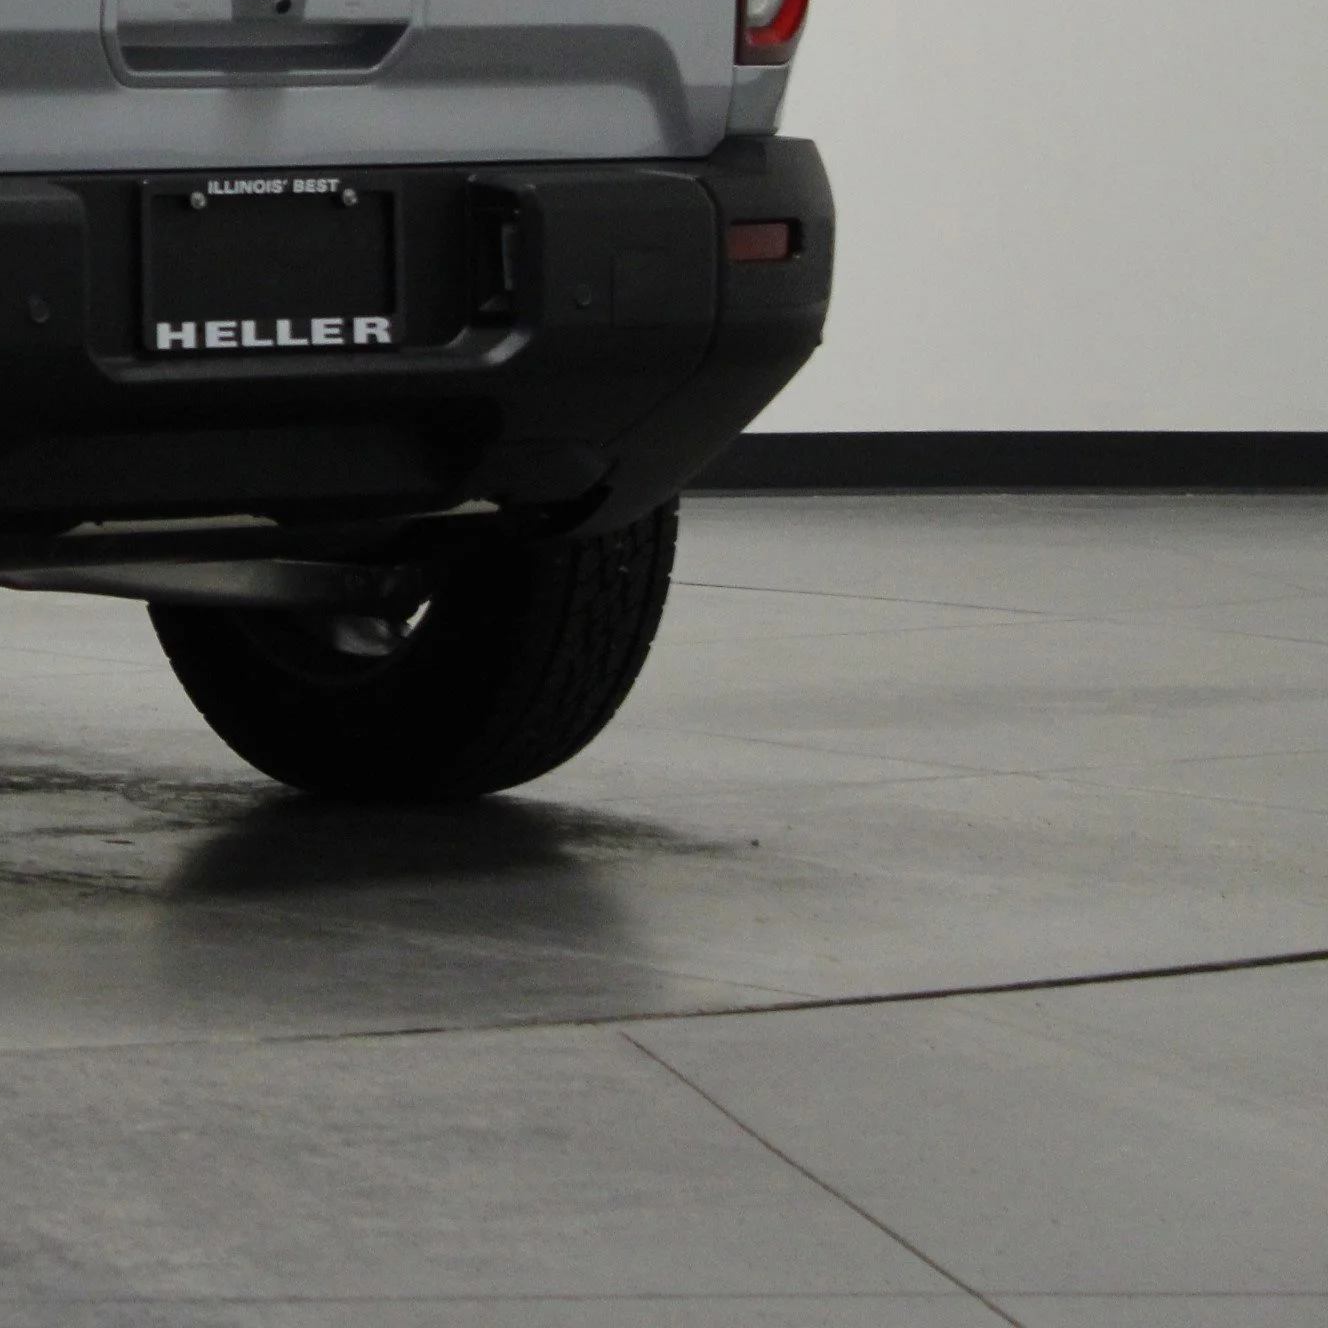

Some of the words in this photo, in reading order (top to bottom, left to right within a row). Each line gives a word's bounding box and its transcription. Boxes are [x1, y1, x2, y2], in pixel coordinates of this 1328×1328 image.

[207, 179, 288, 195] ILLINOIS'
[292, 178, 340, 193] BEST
[156, 316, 392, 350] HELLER
